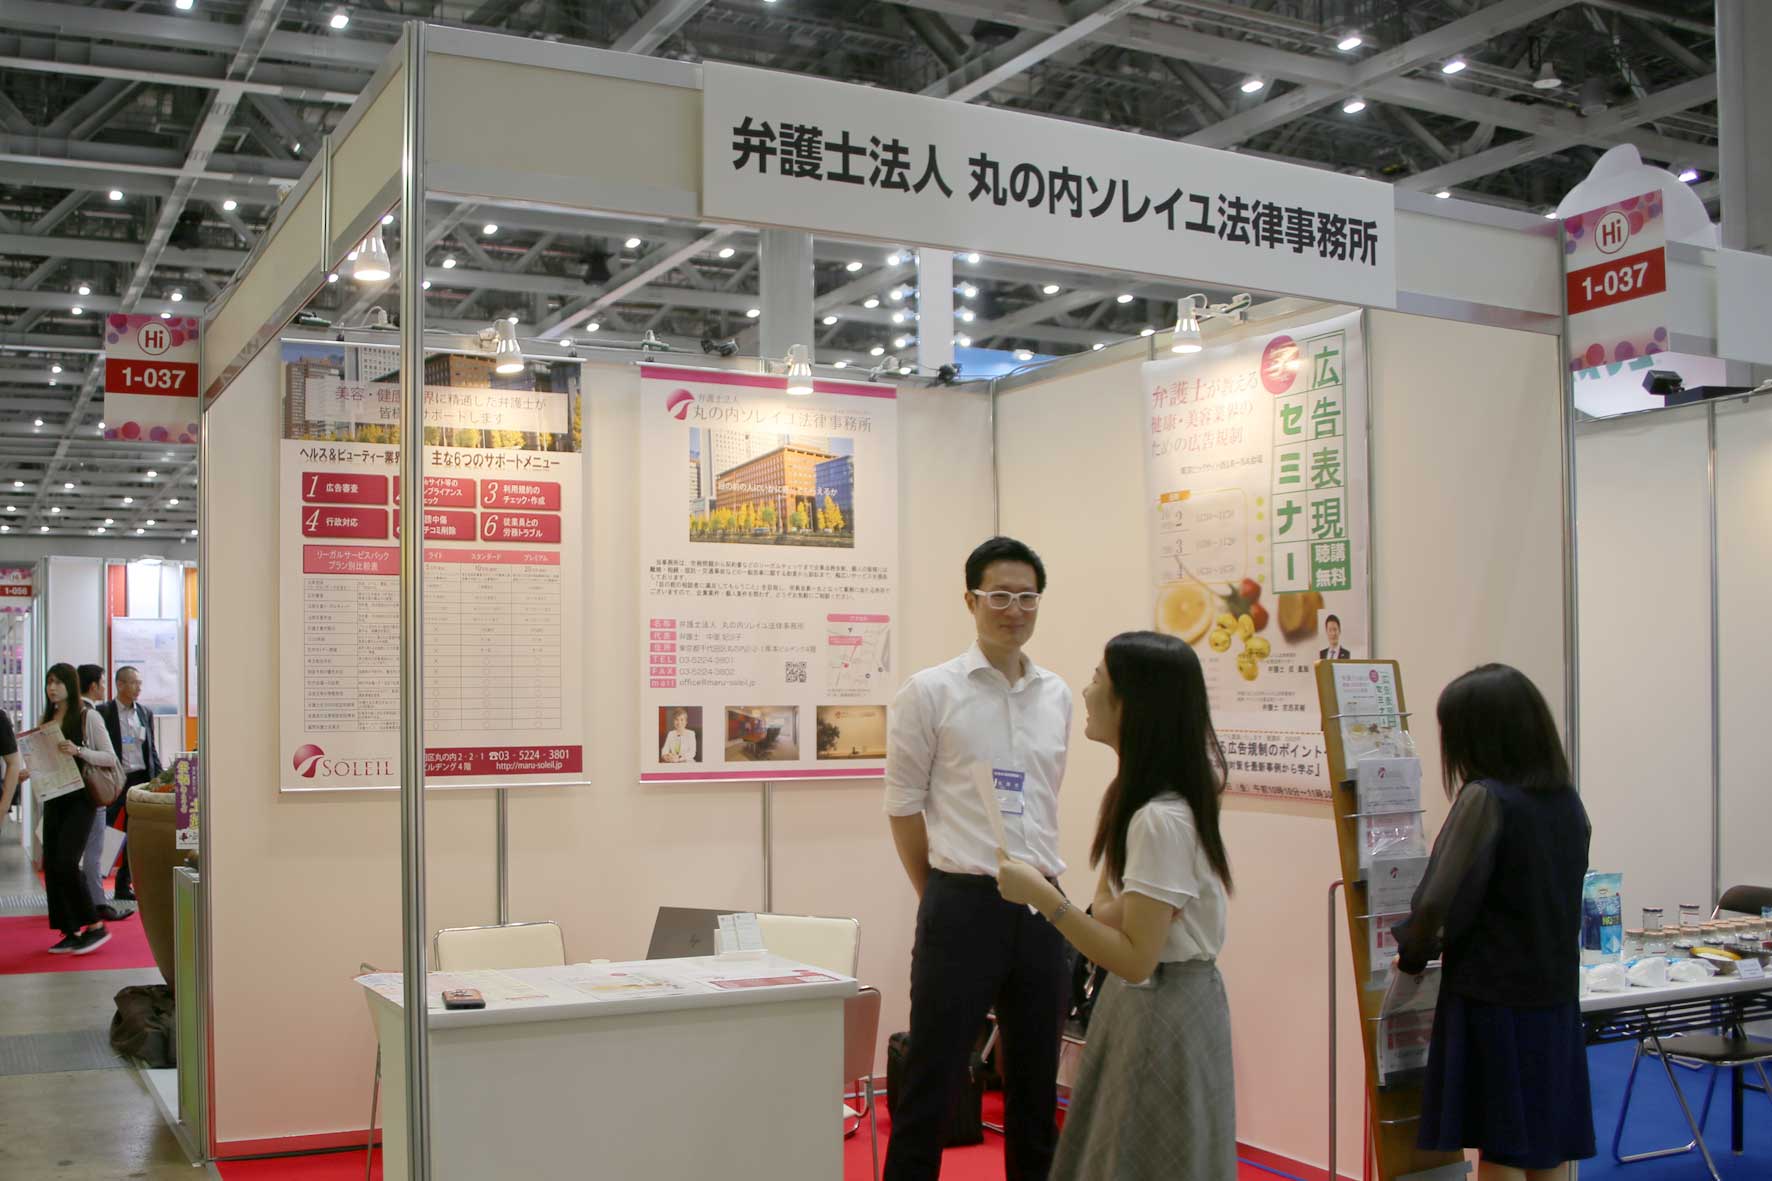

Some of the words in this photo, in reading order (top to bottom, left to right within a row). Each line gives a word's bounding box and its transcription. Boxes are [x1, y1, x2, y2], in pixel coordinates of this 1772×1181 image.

[732, 116, 953, 198] 弁護士法人
[968, 151, 1378, 267] 丸の内ソレイユ法律事務所
[1602, 219, 1621, 247] Hi
[1582, 262, 1648, 301] 1-037
[145, 330, 163, 349] Hi
[122, 367, 186, 389] 1-037
[1311, 345, 1343, 540] 広告表現
[431, 450, 560, 468] 主な6つのサポートメニュー
[307, 476, 319, 498] 1
[326, 483, 359, 494] 広告審査
[484, 481, 498, 503] 3
[1277, 403, 1304, 581] セミナー
[306, 509, 319, 531] 4
[326, 517, 359, 527] 行政対応
[484, 515, 499, 537] 6
[1316, 568, 1346, 588] 無料
[652, 679, 675, 687] mail
[322, 759, 394, 777] SOLEIL
